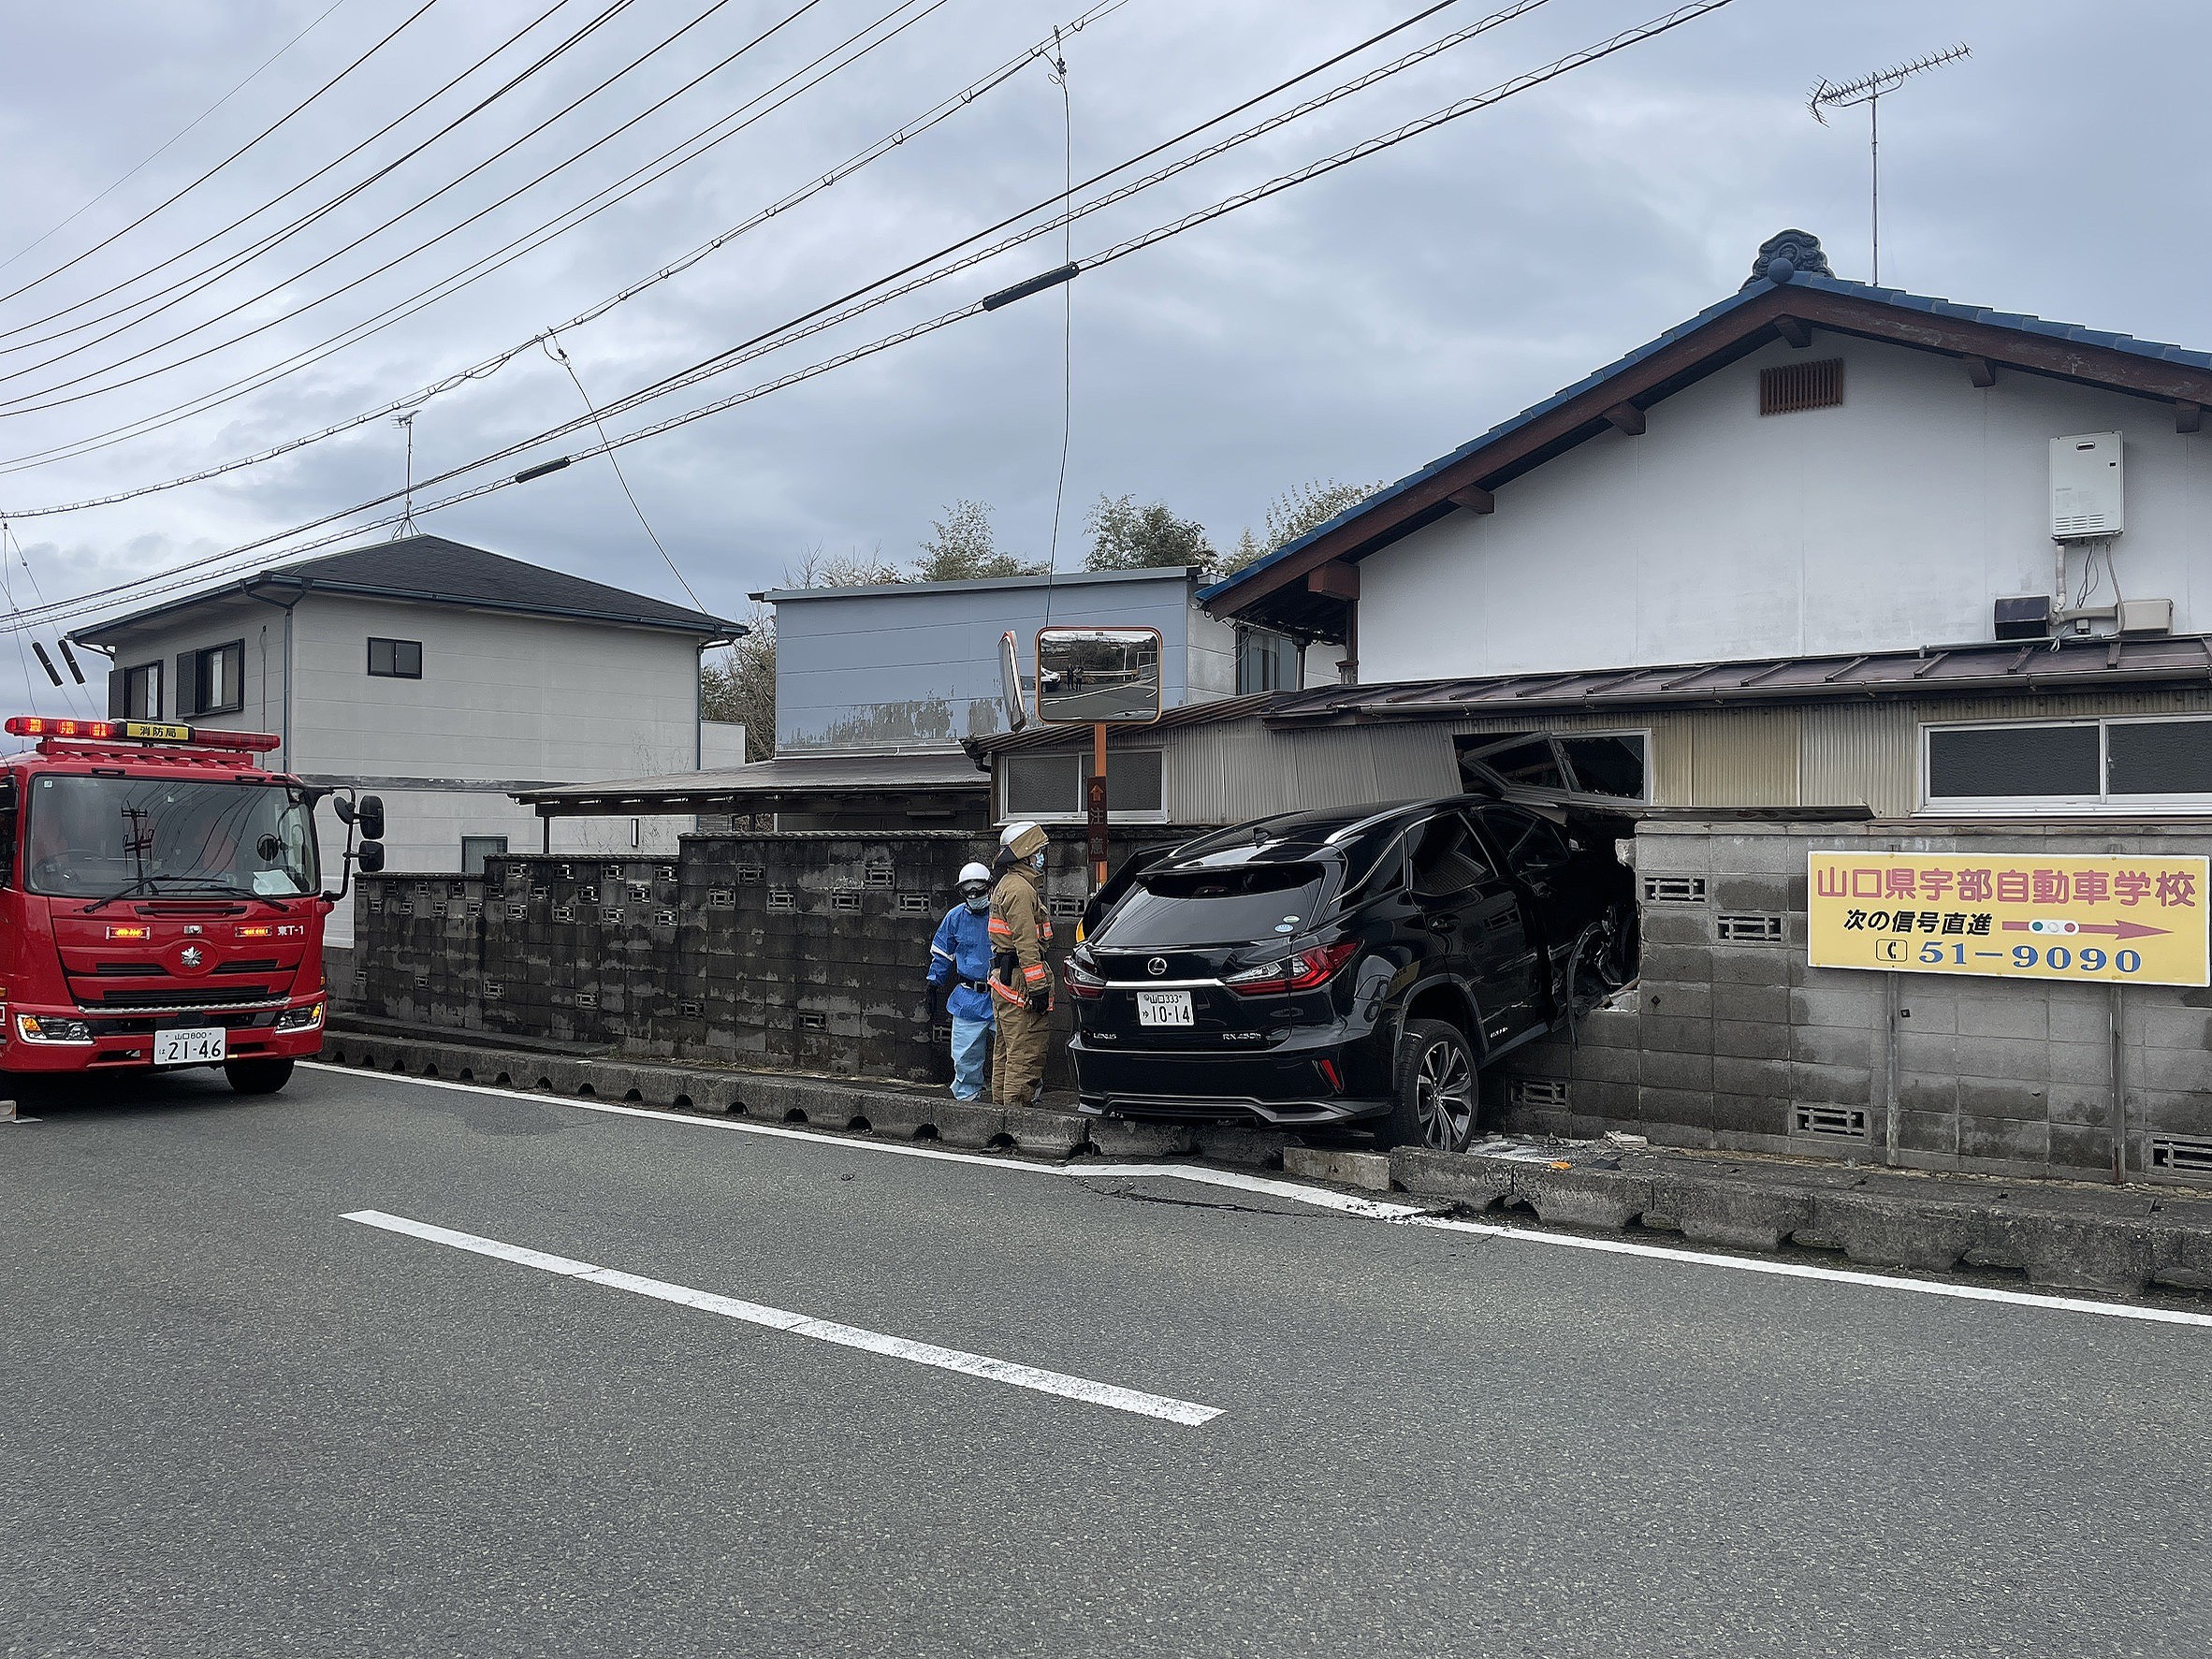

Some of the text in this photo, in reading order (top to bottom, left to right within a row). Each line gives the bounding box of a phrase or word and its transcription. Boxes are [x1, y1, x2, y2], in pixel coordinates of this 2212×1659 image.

[139, 725, 177, 737] 消防局
[1089, 807, 1104, 855] 注意
[1817, 866, 2196, 907] 山口県宇部自動車学校
[1842, 908, 1993, 936] 次の信号直進
[1918, 940, 2142, 973] 51-9090
[1152, 1005, 1190, 1023] 10-14
[167, 1039, 222, 1060] 21-46
